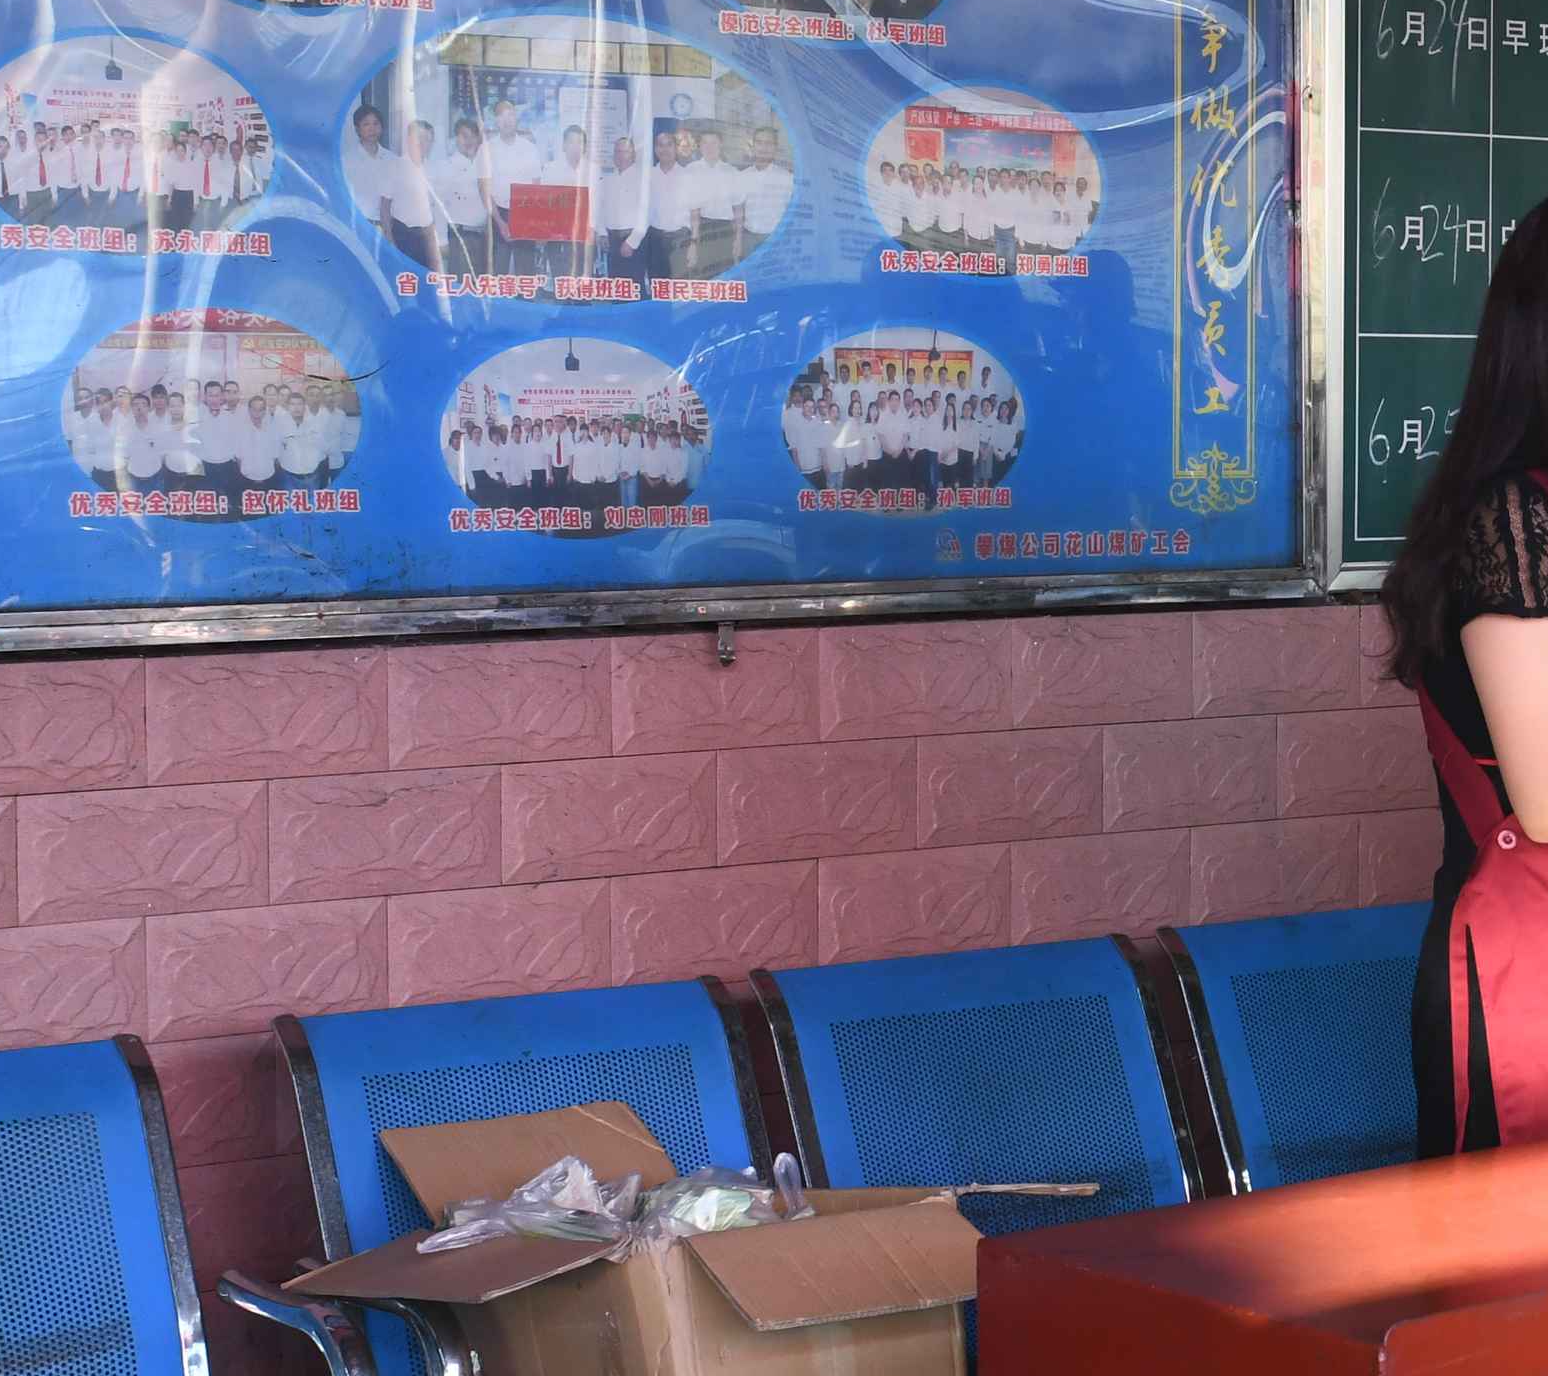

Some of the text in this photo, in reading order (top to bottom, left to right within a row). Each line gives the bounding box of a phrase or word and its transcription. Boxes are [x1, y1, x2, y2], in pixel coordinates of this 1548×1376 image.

[880, 250, 1090, 278] 优秀安全班组：郑勇班组
[974, 529, 1192, 561] 攀煤公司花山煤矿工会
